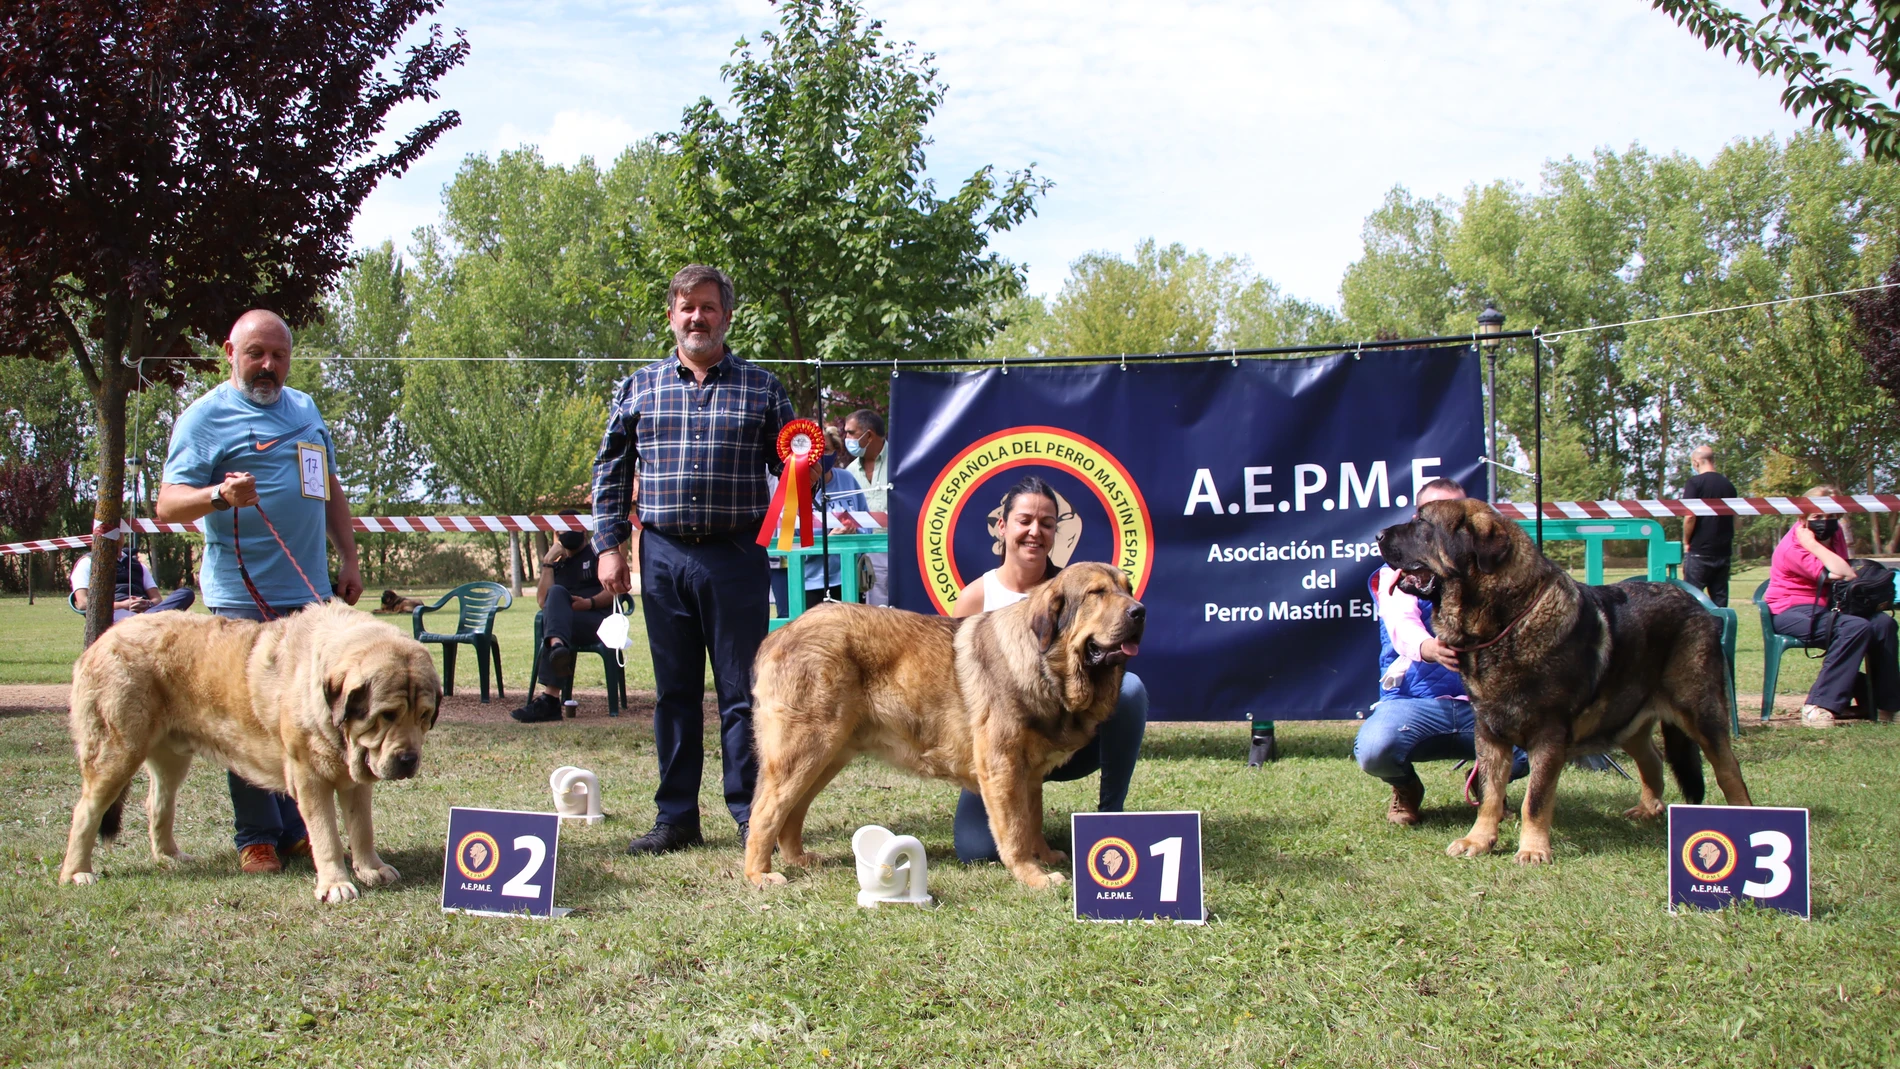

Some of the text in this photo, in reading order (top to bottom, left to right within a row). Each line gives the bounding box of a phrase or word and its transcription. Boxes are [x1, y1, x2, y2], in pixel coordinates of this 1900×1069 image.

[305, 457, 318, 474] 17
[1183, 457, 1442, 515] A.E.P.M.E
[928, 440, 1138, 603] ASOCIACIÓN ESPAÑOLA DEL PERRO MASTÍN ESPAÑ
[1207, 540, 1382, 563] Asociación Espa
[1301, 569, 1336, 590] del
[1204, 602, 1263, 622] Perro
[1268, 600, 1343, 621] Mastín
[501, 834, 547, 898] 2
[1149, 836, 1183, 902] 1
[1742, 830, 1792, 899] 3
[460, 882, 493, 893] A.E.P.M.E.
[1096, 891, 1134, 900] A.E.P.M.E.
[1690, 884, 1731, 894] A.E.P.M.E.
